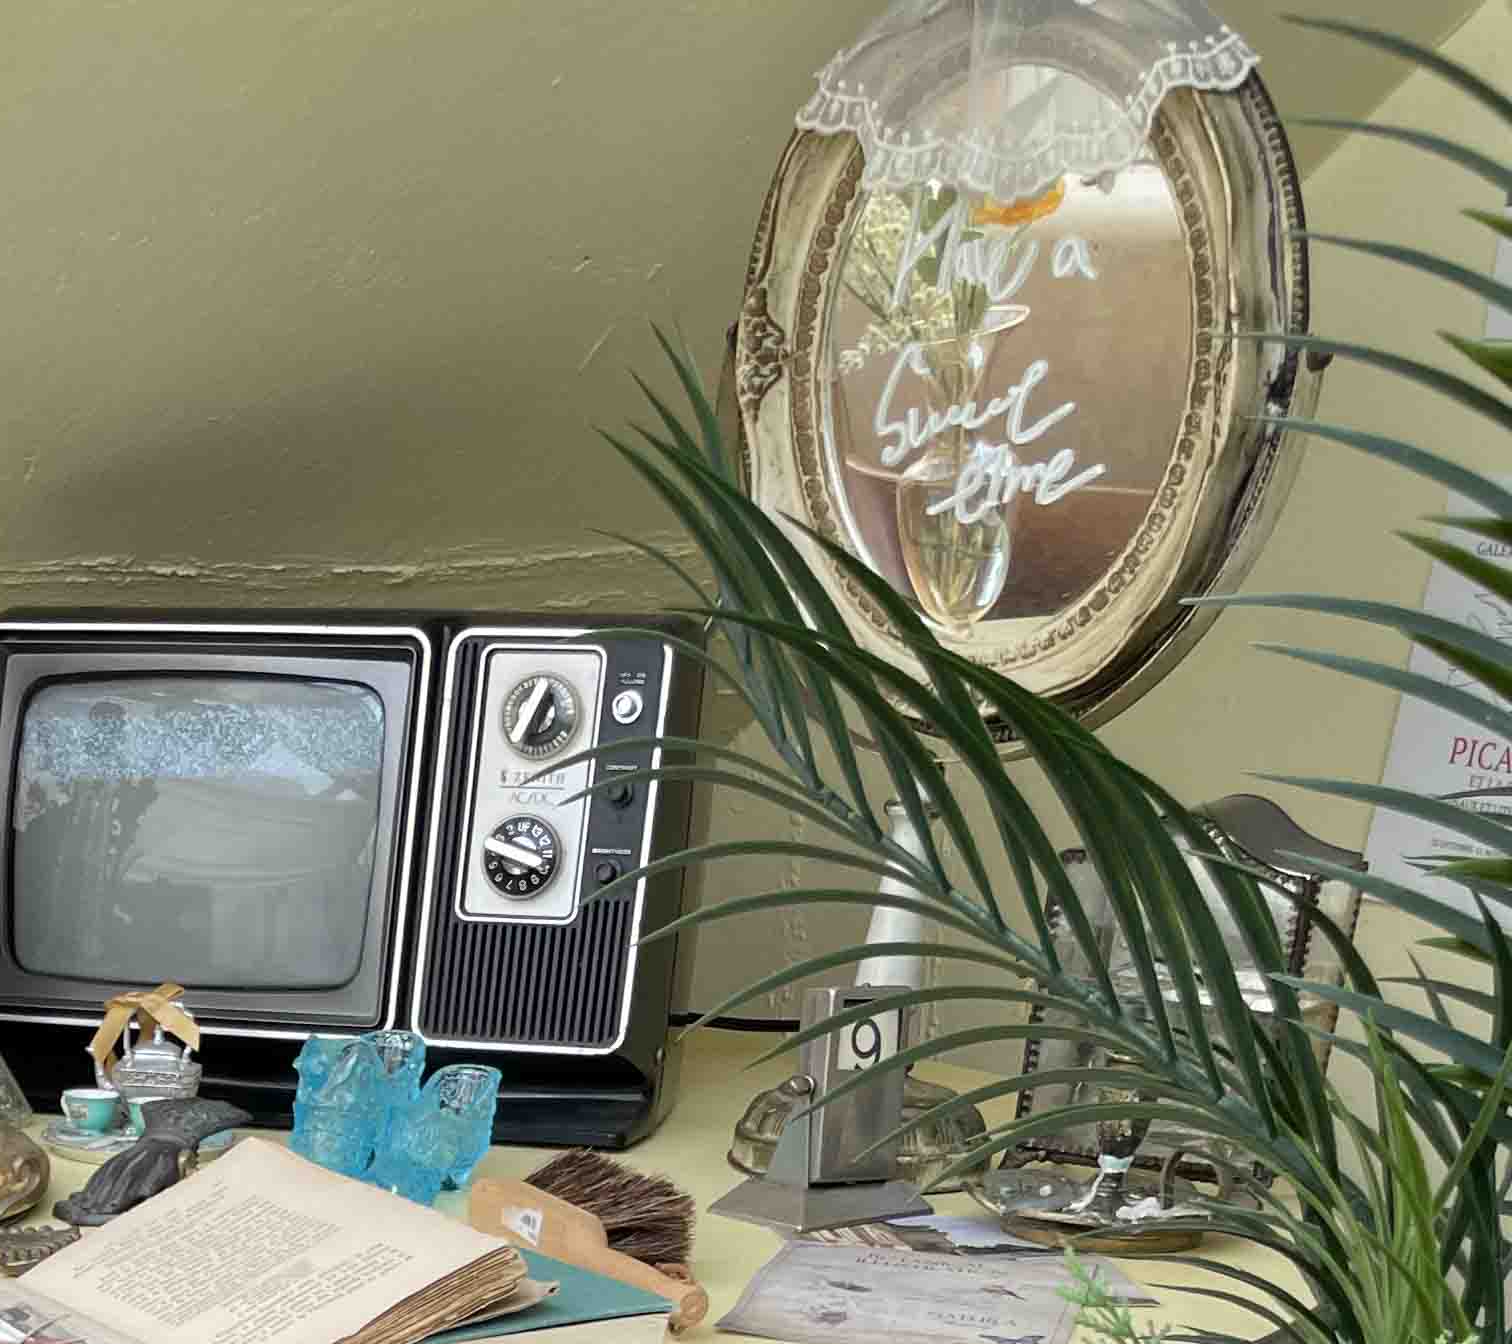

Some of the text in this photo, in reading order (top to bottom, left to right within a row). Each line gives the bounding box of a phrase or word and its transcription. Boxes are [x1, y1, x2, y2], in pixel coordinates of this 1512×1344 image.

[1052, 233, 1097, 280] a
[926, 440, 1107, 525] time
[852, 1018, 881, 1071] 9
